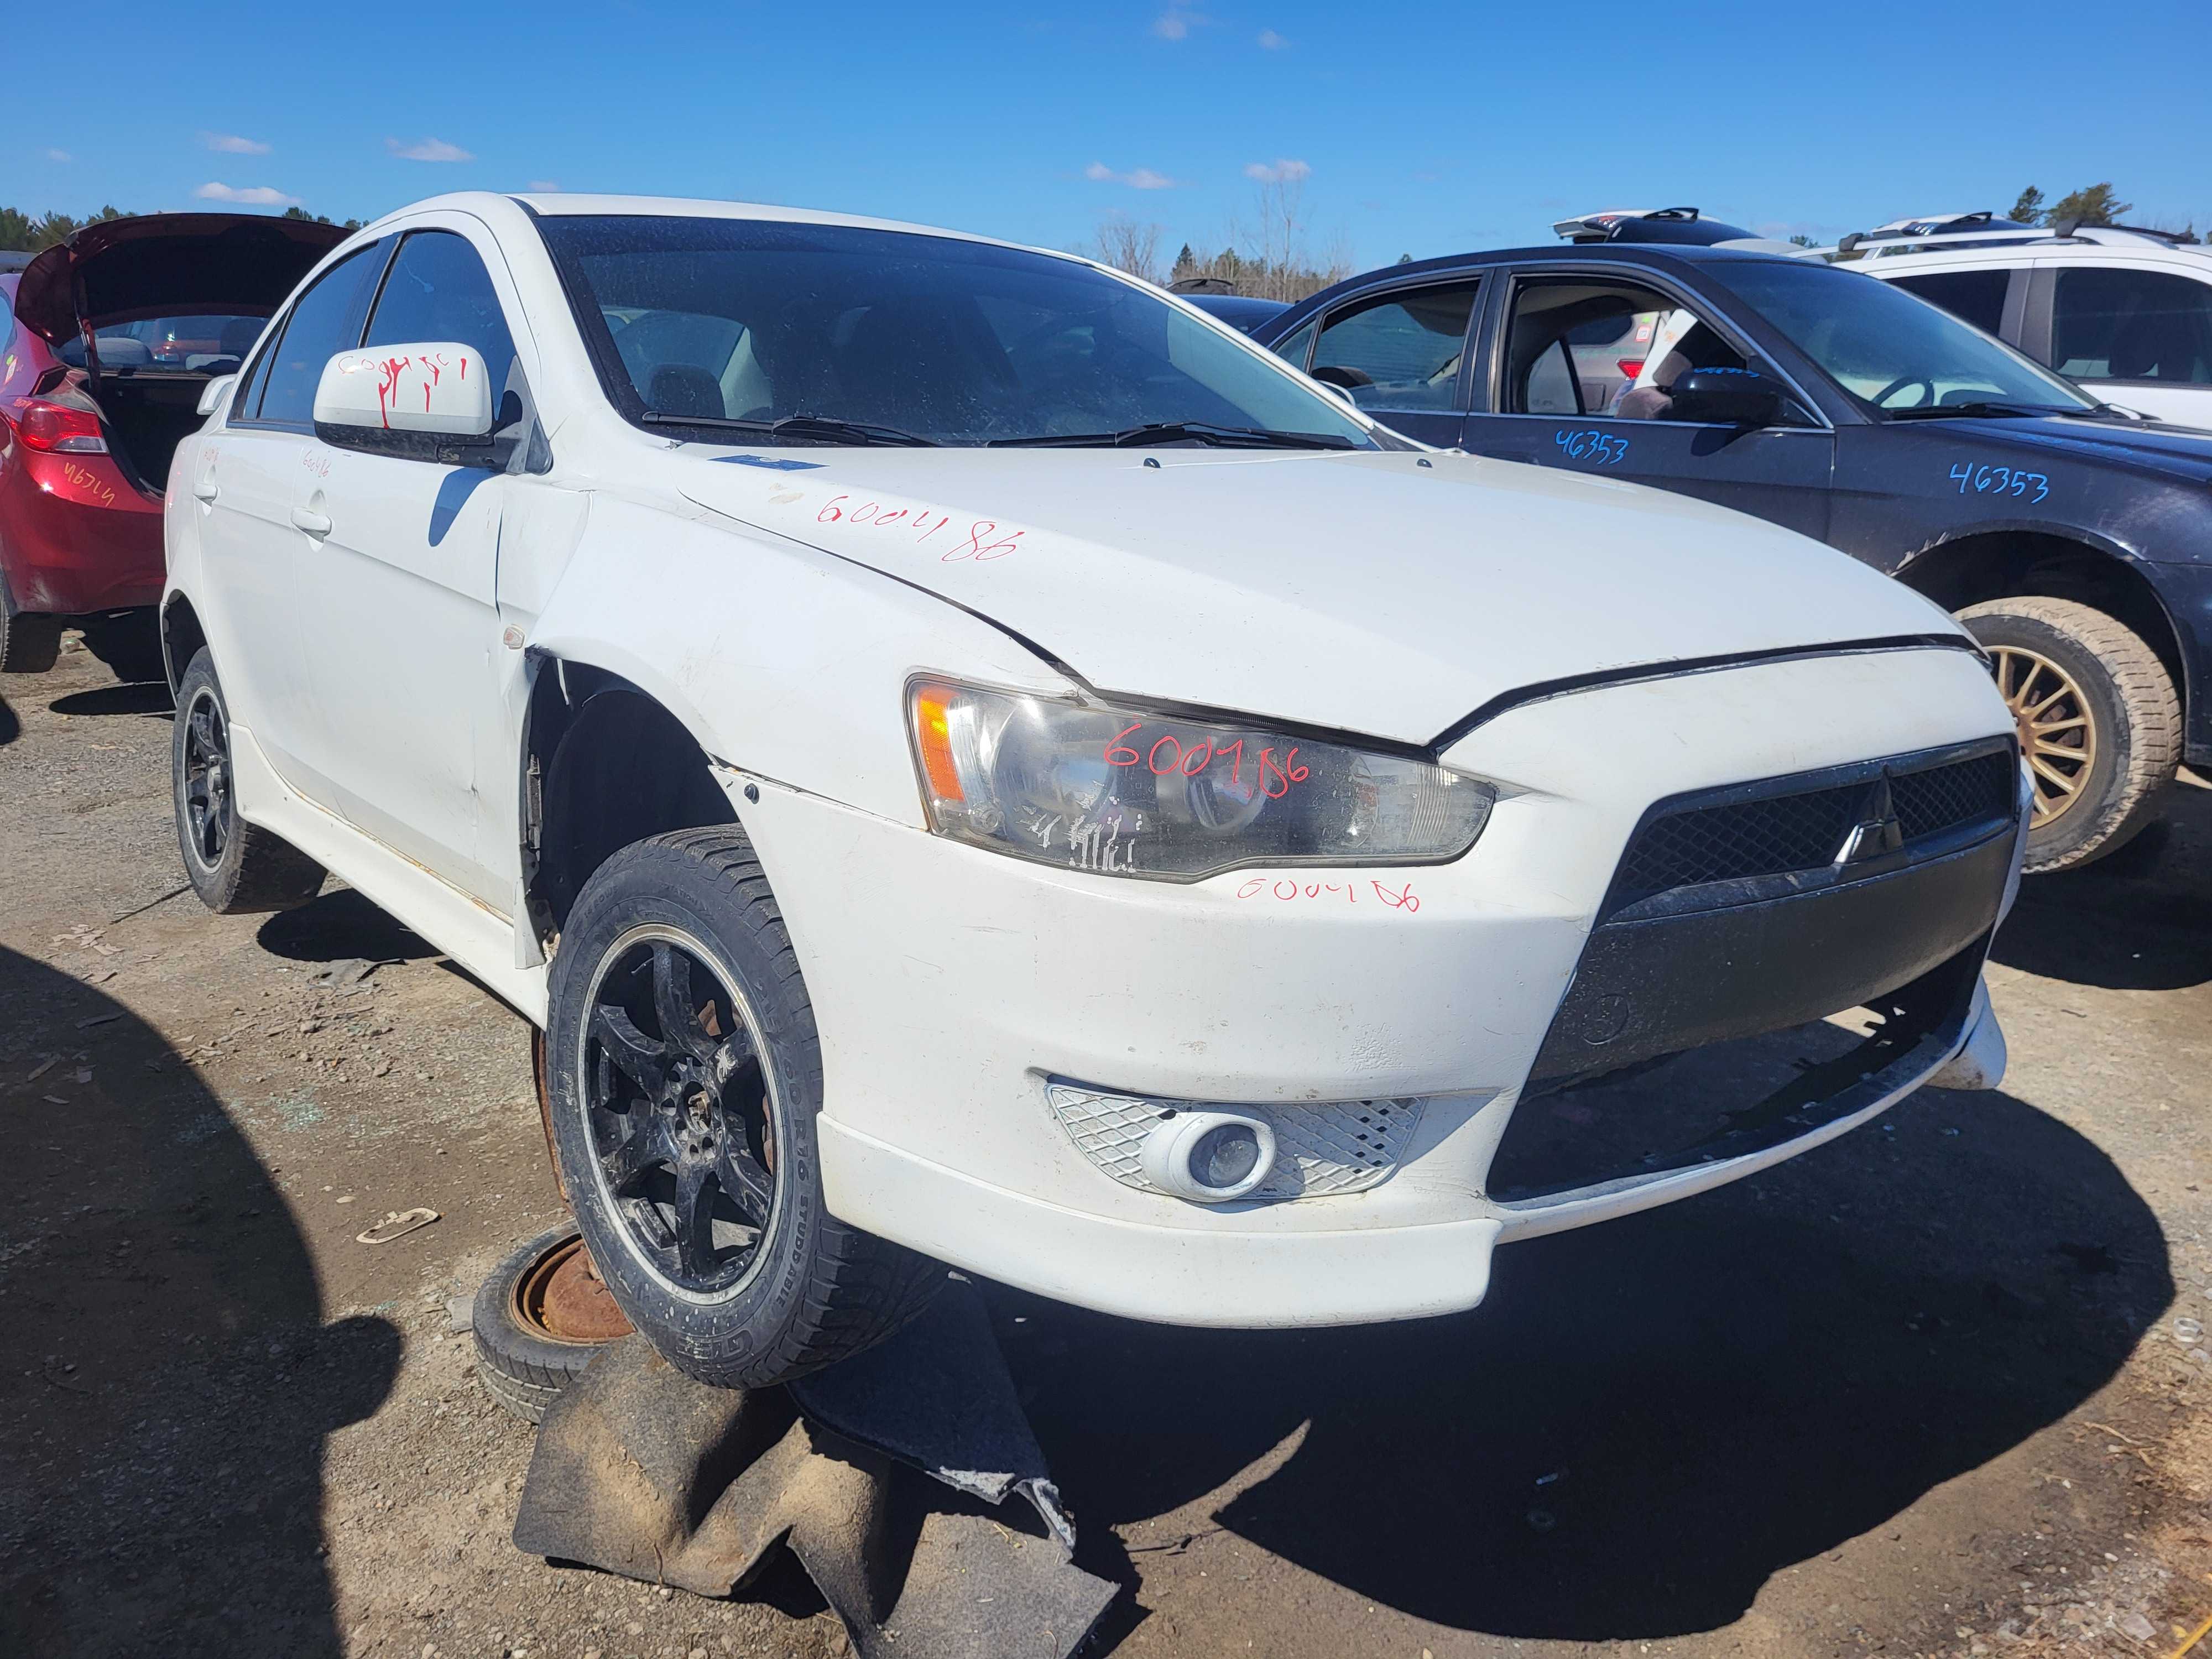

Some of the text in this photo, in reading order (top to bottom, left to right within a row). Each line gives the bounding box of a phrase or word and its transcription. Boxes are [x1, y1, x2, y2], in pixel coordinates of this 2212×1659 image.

[1554, 428, 1630, 466] 46353
[1949, 461, 2050, 505] 46353
[793, 1118, 810, 1182] R16
[775, 1194, 810, 1308] STUDDABLE
